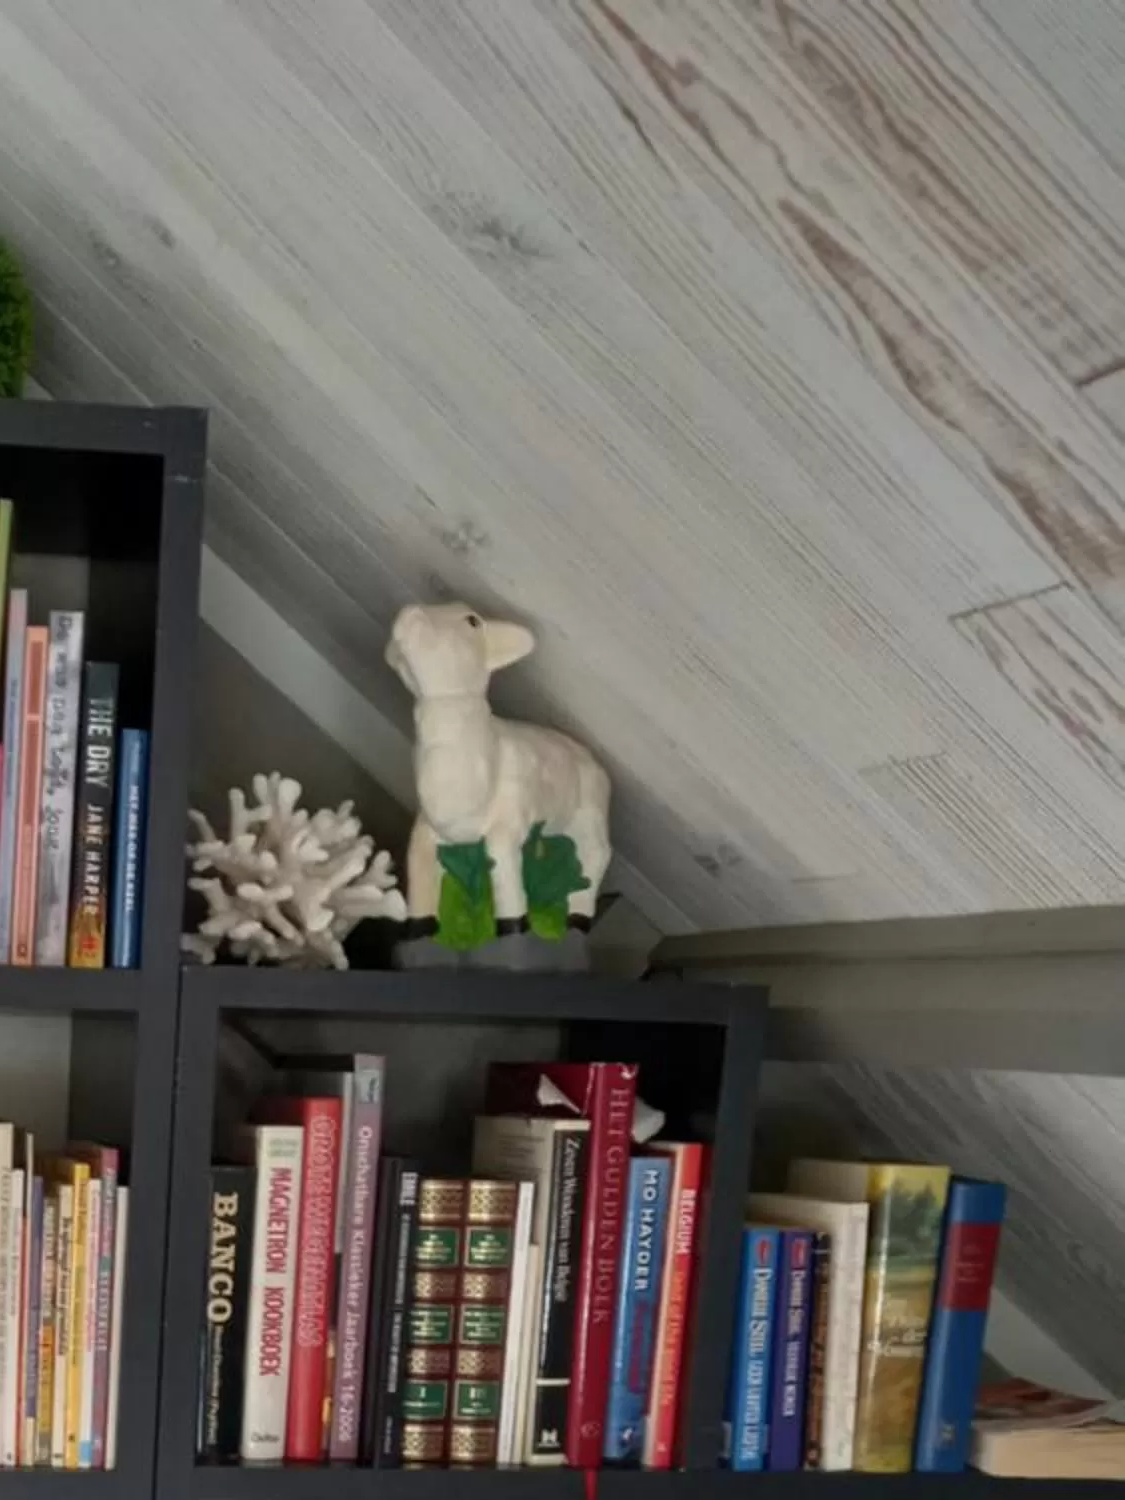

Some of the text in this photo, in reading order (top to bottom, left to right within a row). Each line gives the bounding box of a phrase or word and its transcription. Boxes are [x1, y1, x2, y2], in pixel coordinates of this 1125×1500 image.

[82, 697, 114, 916] THE DRY JANE HARPER
[597, 1145, 625, 1254] GULDEN
[642, 1169, 660, 1202] MO
[675, 1189, 696, 1255] BELGIUM
[206, 1191, 239, 1326] BANCO
[259, 1167, 294, 1376] MAGNETRON KOOKBOEK
[634, 1208, 655, 1291] HAYDER
